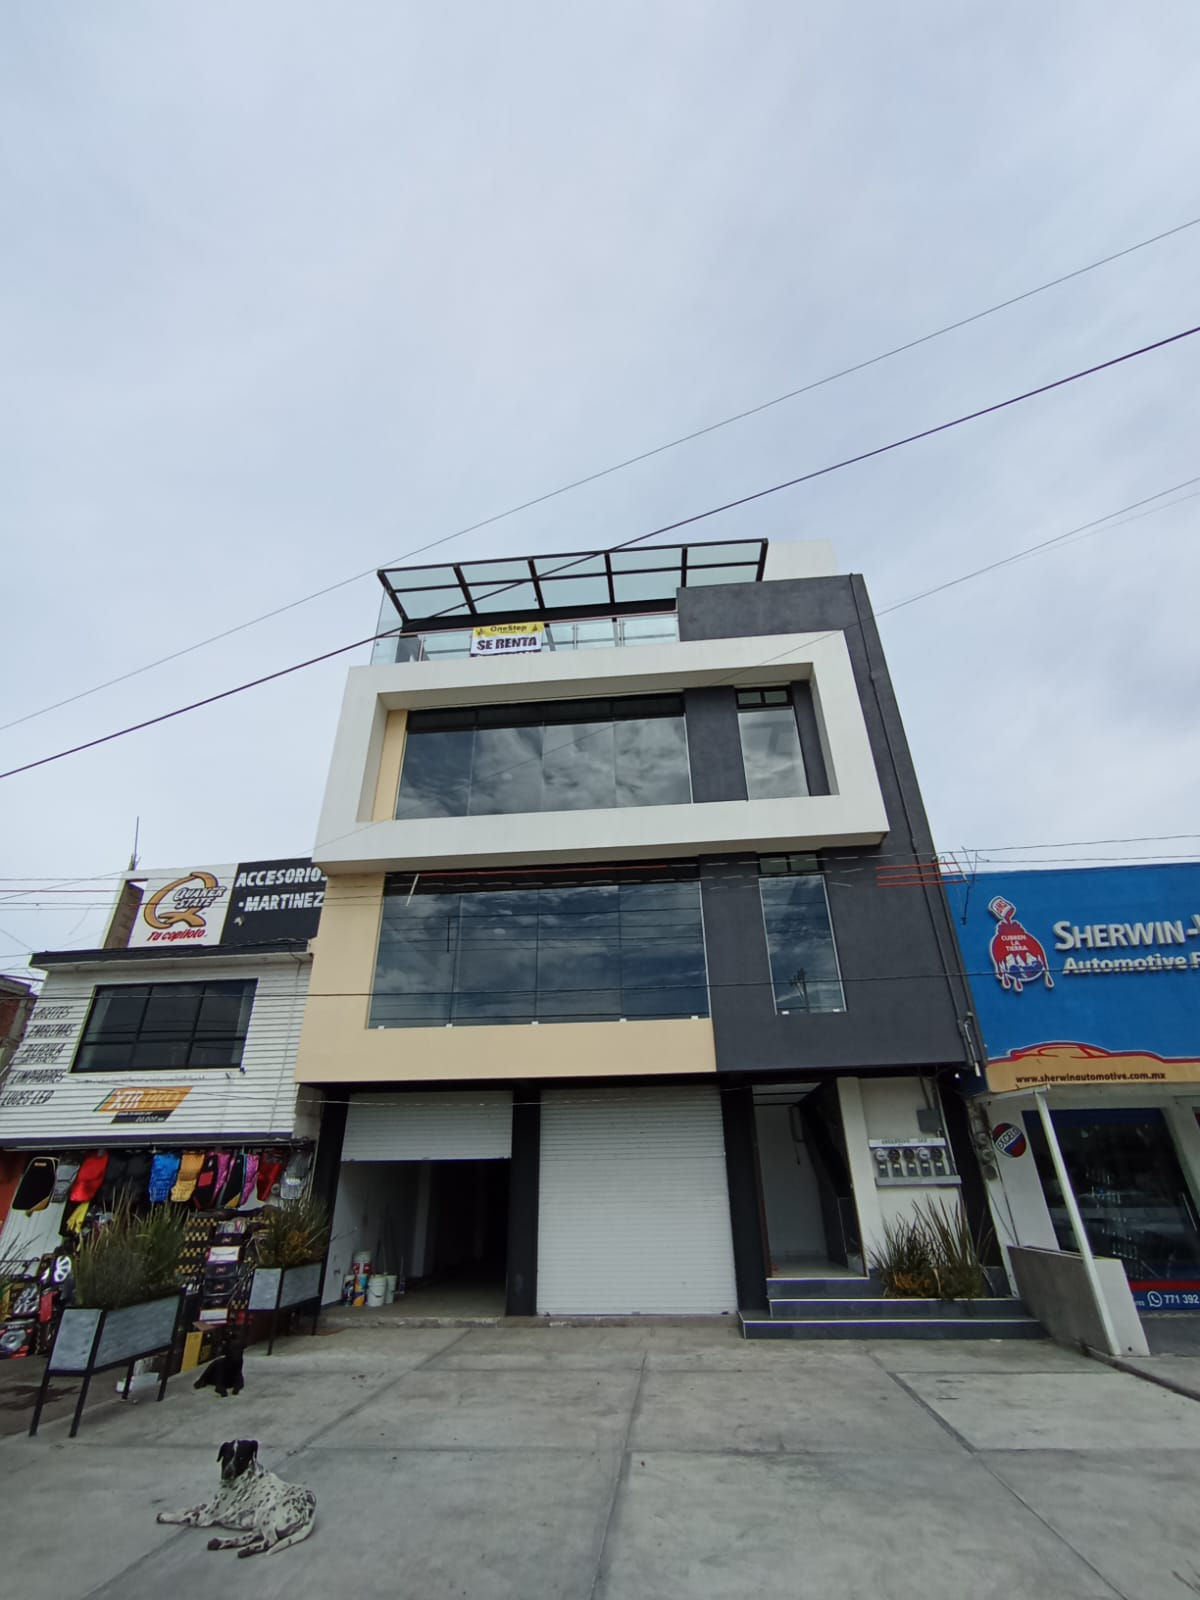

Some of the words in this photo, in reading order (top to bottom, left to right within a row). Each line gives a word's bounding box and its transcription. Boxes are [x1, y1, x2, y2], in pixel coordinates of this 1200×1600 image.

[490, 625, 527, 633] OneStep
[477, 639, 493, 651] SE
[496, 636, 537, 649] RENTA
[235, 866, 328, 888] ACCESORIO
[173, 886, 227, 902] QUAKER
[244, 891, 325, 912] MARTINEZ
[175, 897, 215, 909] STATE
[161, 929, 206, 942] copiloto
[1053, 913, 1200, 951] SHERWIN-
[1062, 953, 1188, 975] Automotive
[1016, 1072, 1166, 1083] www.sherwinautomotive.com.mx
[1164, 1294, 1181, 1304] 771
[1182, 1294, 1200, 1304] 392
